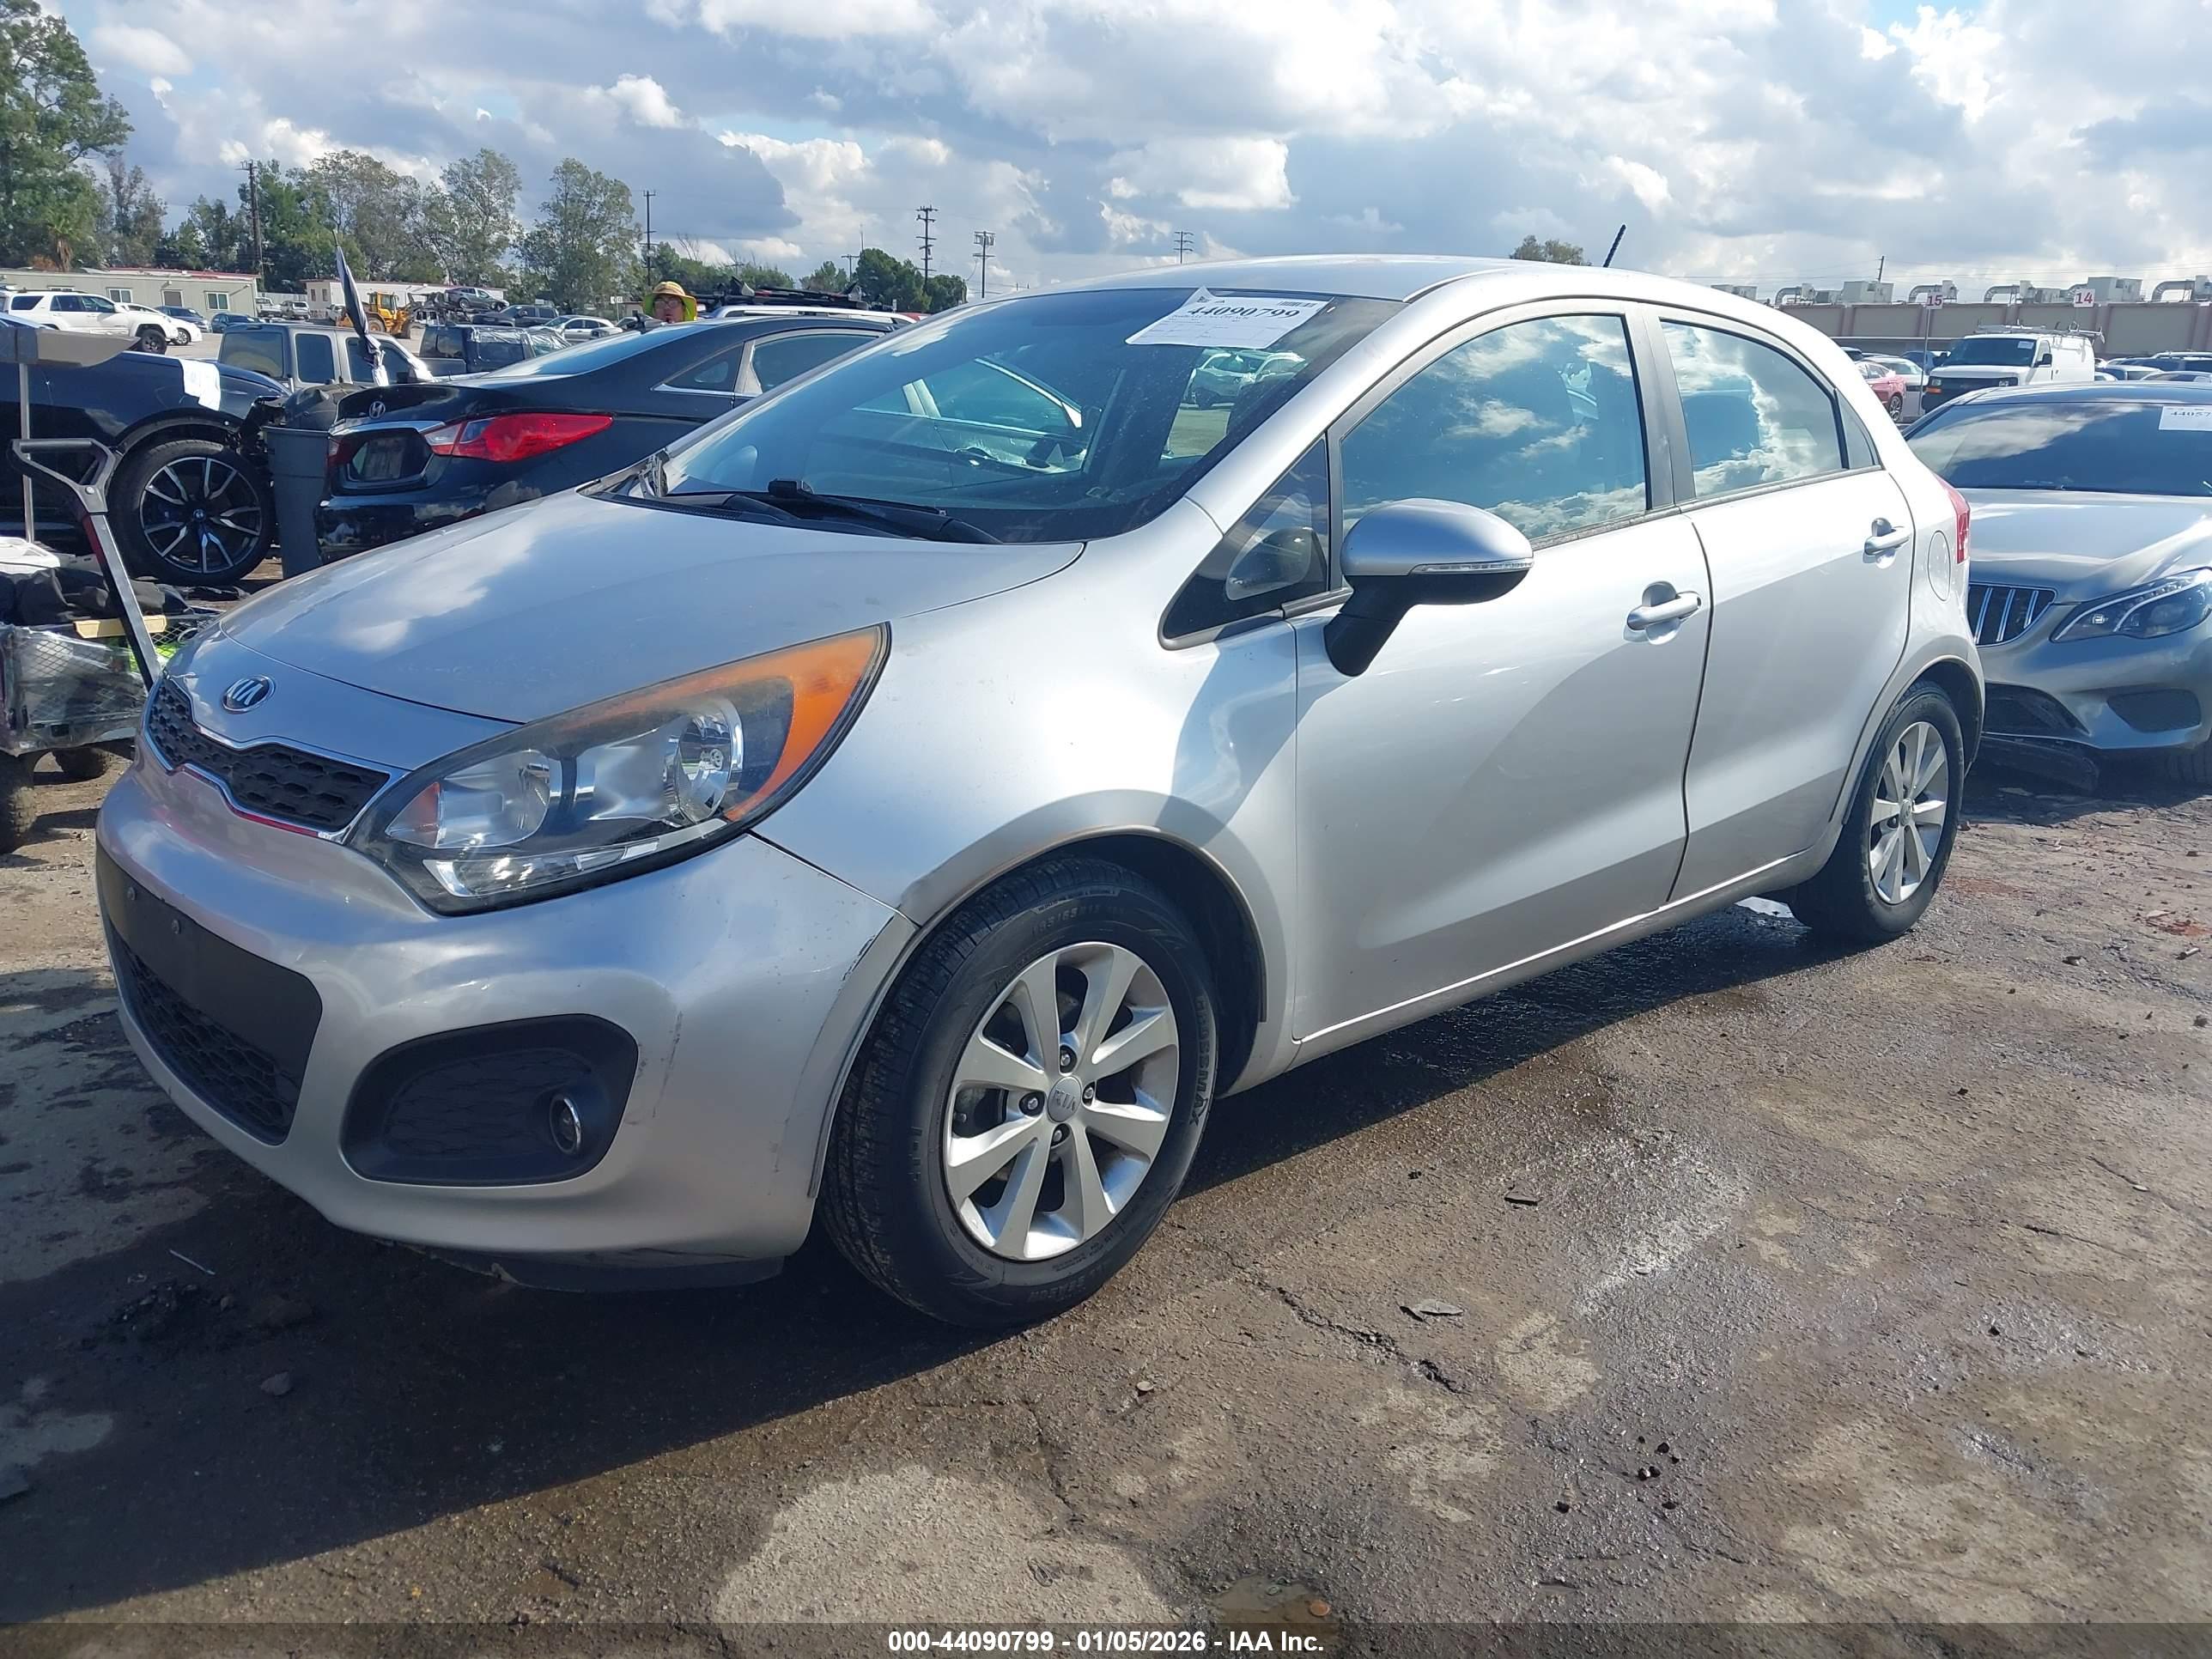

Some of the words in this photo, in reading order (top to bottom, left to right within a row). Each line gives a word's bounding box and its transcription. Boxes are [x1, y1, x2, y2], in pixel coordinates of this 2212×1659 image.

[1927, 295, 1942, 306] 15
[2075, 292, 2093, 304] 14
[1188, 306, 1300, 319] 44090799
